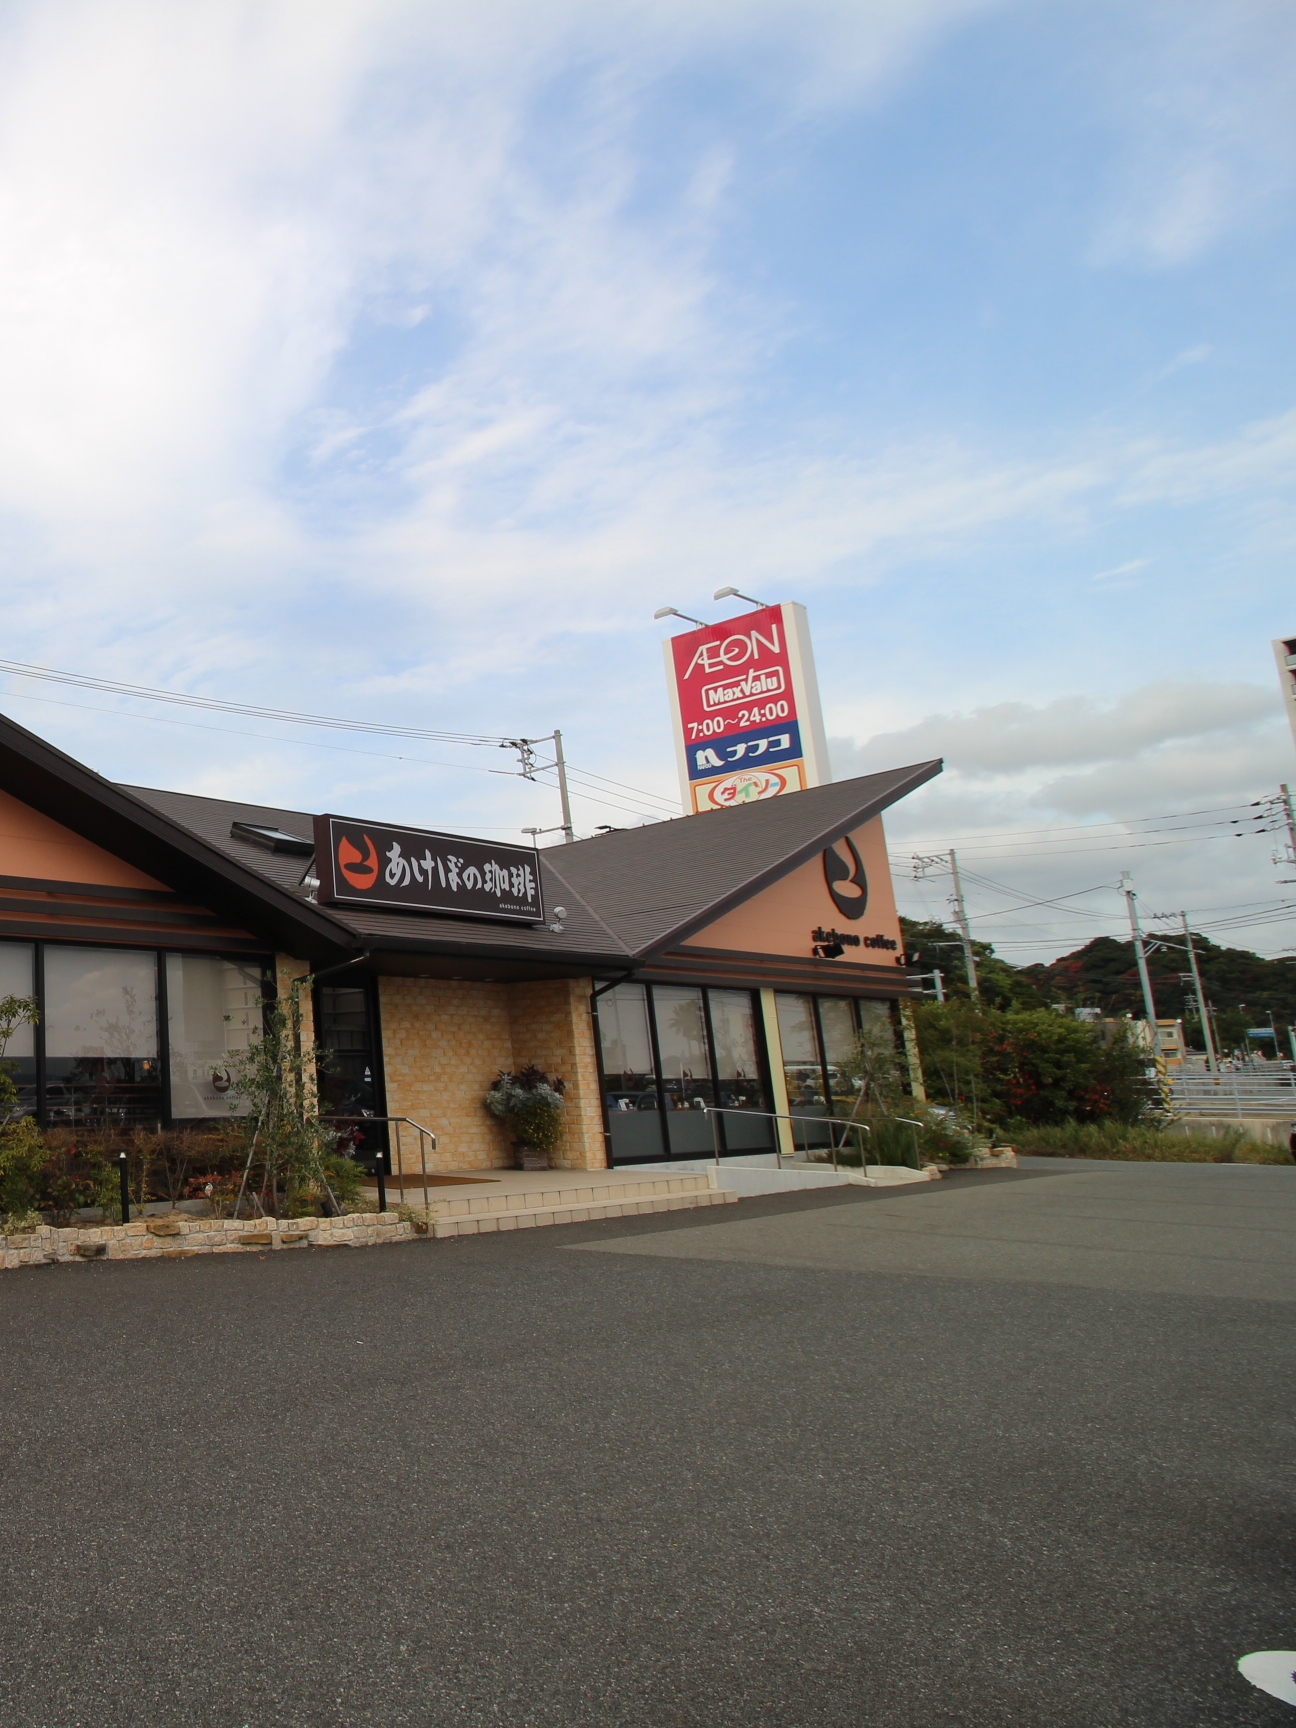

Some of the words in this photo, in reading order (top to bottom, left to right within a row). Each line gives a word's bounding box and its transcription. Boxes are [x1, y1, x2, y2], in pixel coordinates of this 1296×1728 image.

[708, 669, 778, 706] MaxValu
[726, 733, 791, 761] ナフコ
[721, 779, 780, 802] ダイソー
[385, 842, 535, 902] あけぼの珈琲
[863, 934, 898, 951] coffee
